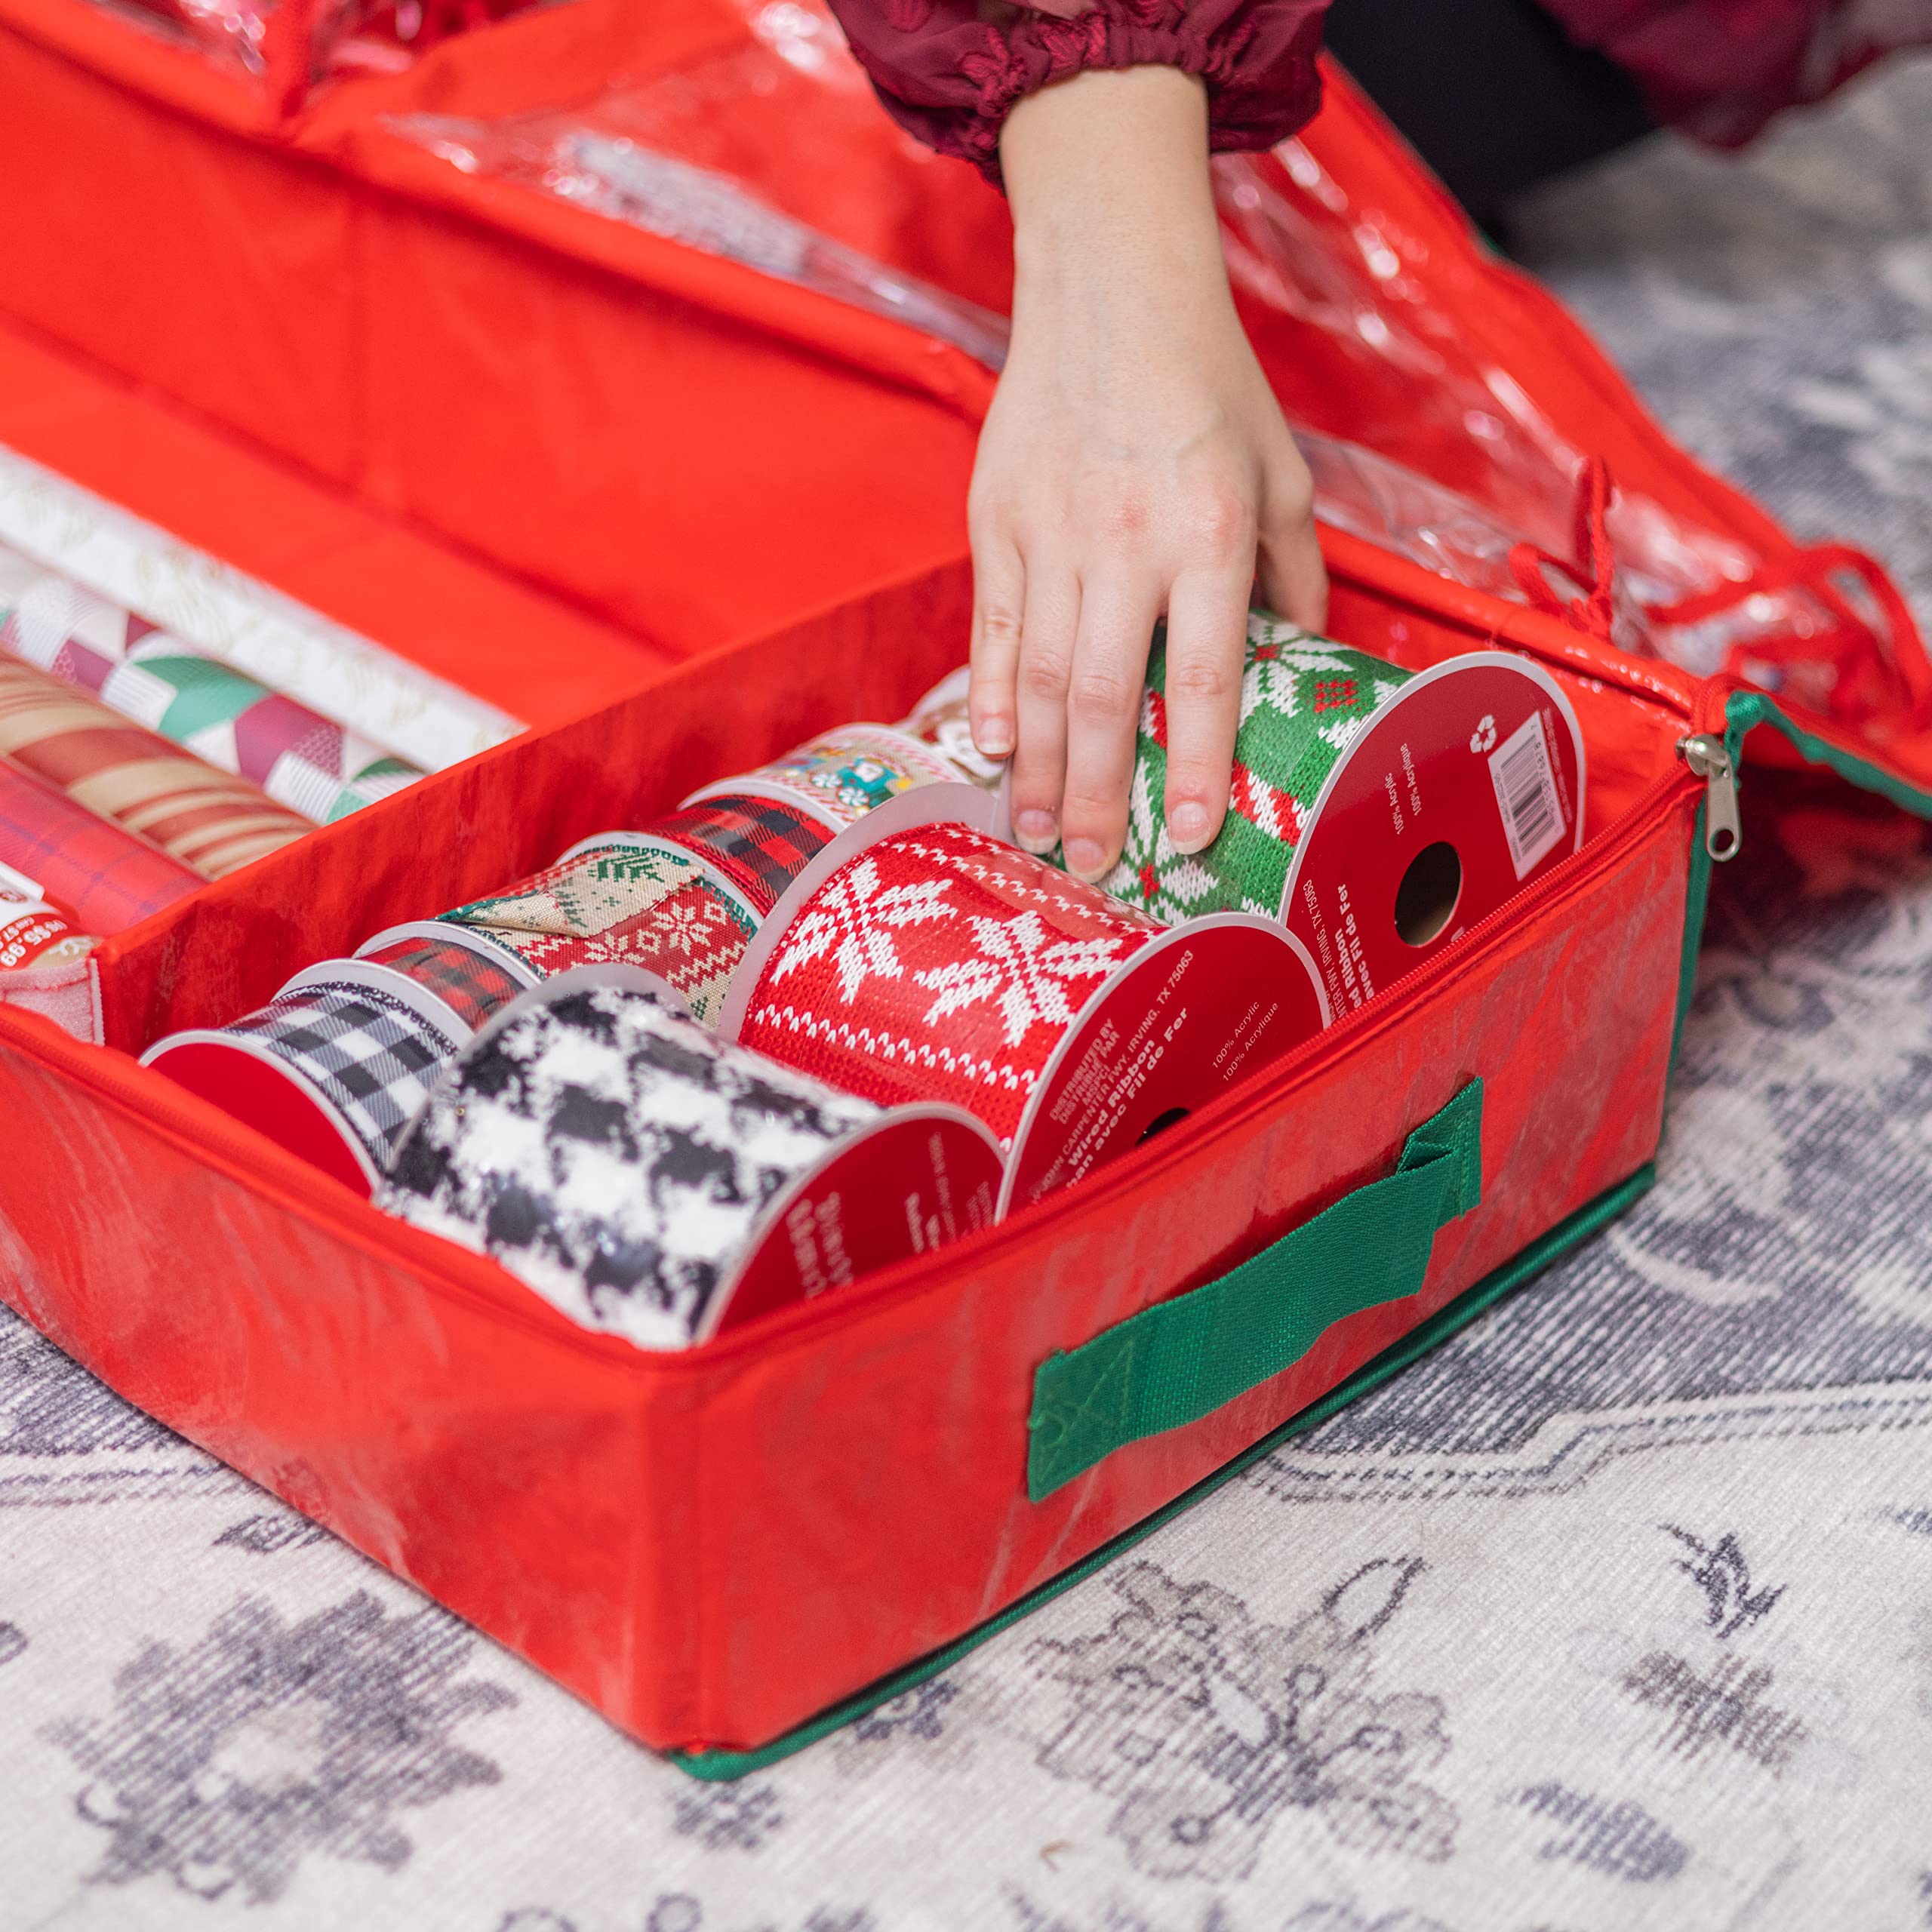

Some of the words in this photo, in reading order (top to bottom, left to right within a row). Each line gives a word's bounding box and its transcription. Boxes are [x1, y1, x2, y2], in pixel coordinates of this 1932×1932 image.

[1400, 743, 1416, 789] Acrylique
[1385, 772, 1398, 807] Acrylic
[1410, 786, 1422, 816] 100%
[1392, 804, 1404, 835] 100%
[1303, 878, 1321, 915] 75063
[1337, 883, 1351, 915] Fer
[1311, 909, 1321, 930] TX
[1346, 912, 1357, 936] de
[1334, 928, 1355, 990] Ribbon
[1349, 935, 1363, 963] Fil
[1358, 960, 1375, 1001] avec
[1062, 1082, 1111, 1156] CARPENTER
[1156, 986, 1171, 1005] TX
[1167, 949, 1195, 989] 75063
[1099, 1029, 1120, 1058] PAR
[1212, 1039, 1235, 1069] 100%
[1233, 1001, 1260, 1039] Acrylic
[1223, 1052, 1245, 1082] 100%
[1244, 1002, 1278, 1052] Acrylique
[1049, 1037, 1103, 1121] DISTRIBUTED
[1099, 1017, 1115, 1039] BY
[1094, 1103, 1128, 1152] avec
[1126, 1071, 1147, 1100] Fil
[1146, 1045, 1164, 1072] de
[1163, 1007, 1188, 1043] Fer
[1067, 1109, 1109, 1167] Wired
[1107, 1039, 1155, 1109] Ribbon
